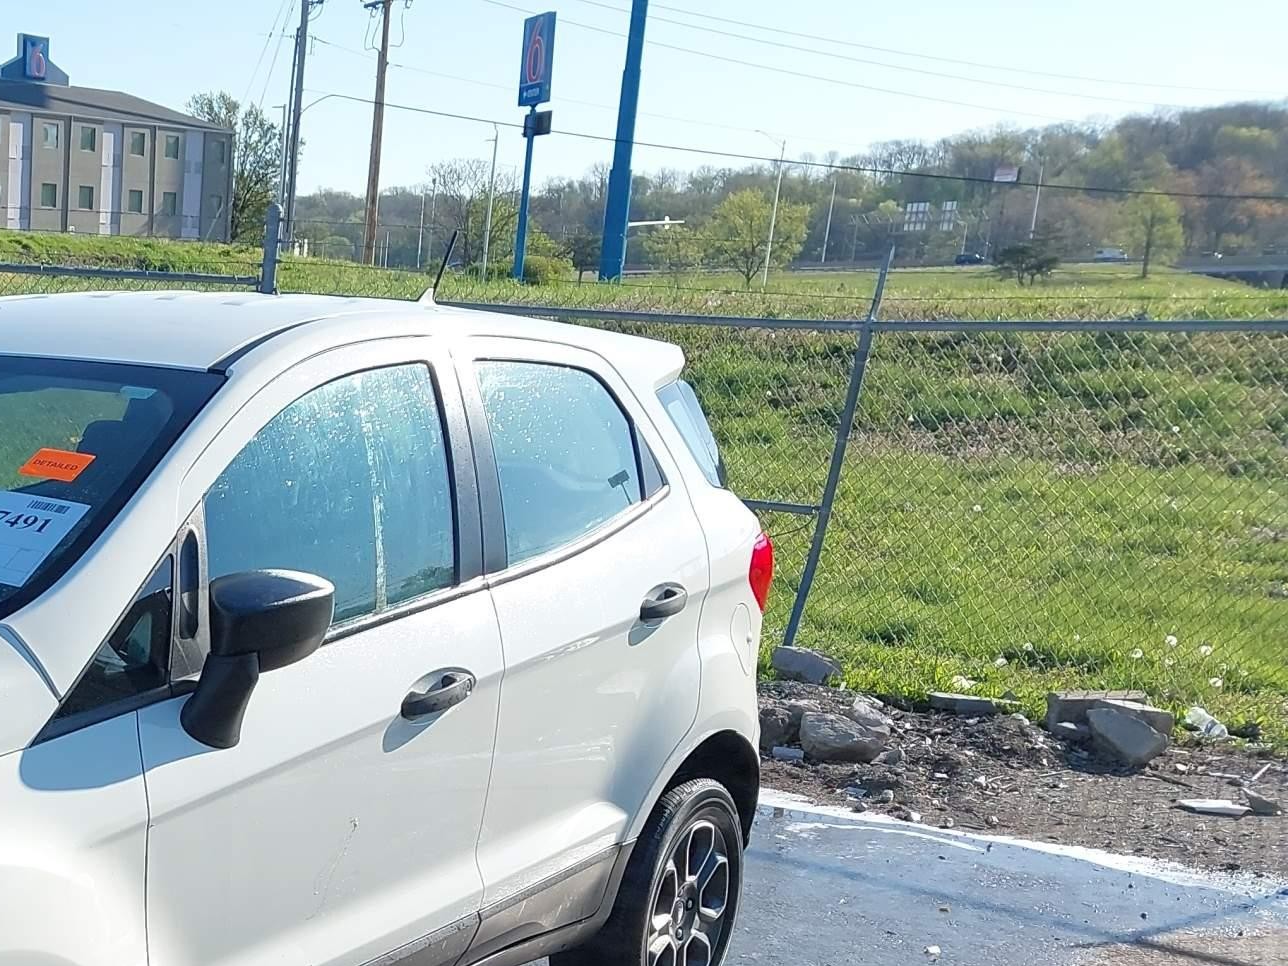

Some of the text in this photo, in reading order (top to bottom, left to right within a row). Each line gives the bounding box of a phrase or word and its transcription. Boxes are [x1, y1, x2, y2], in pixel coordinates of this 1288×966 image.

[30, 43, 46, 78] 6
[526, 17, 544, 83] 6
[32, 459, 79, 471] DETAILED
